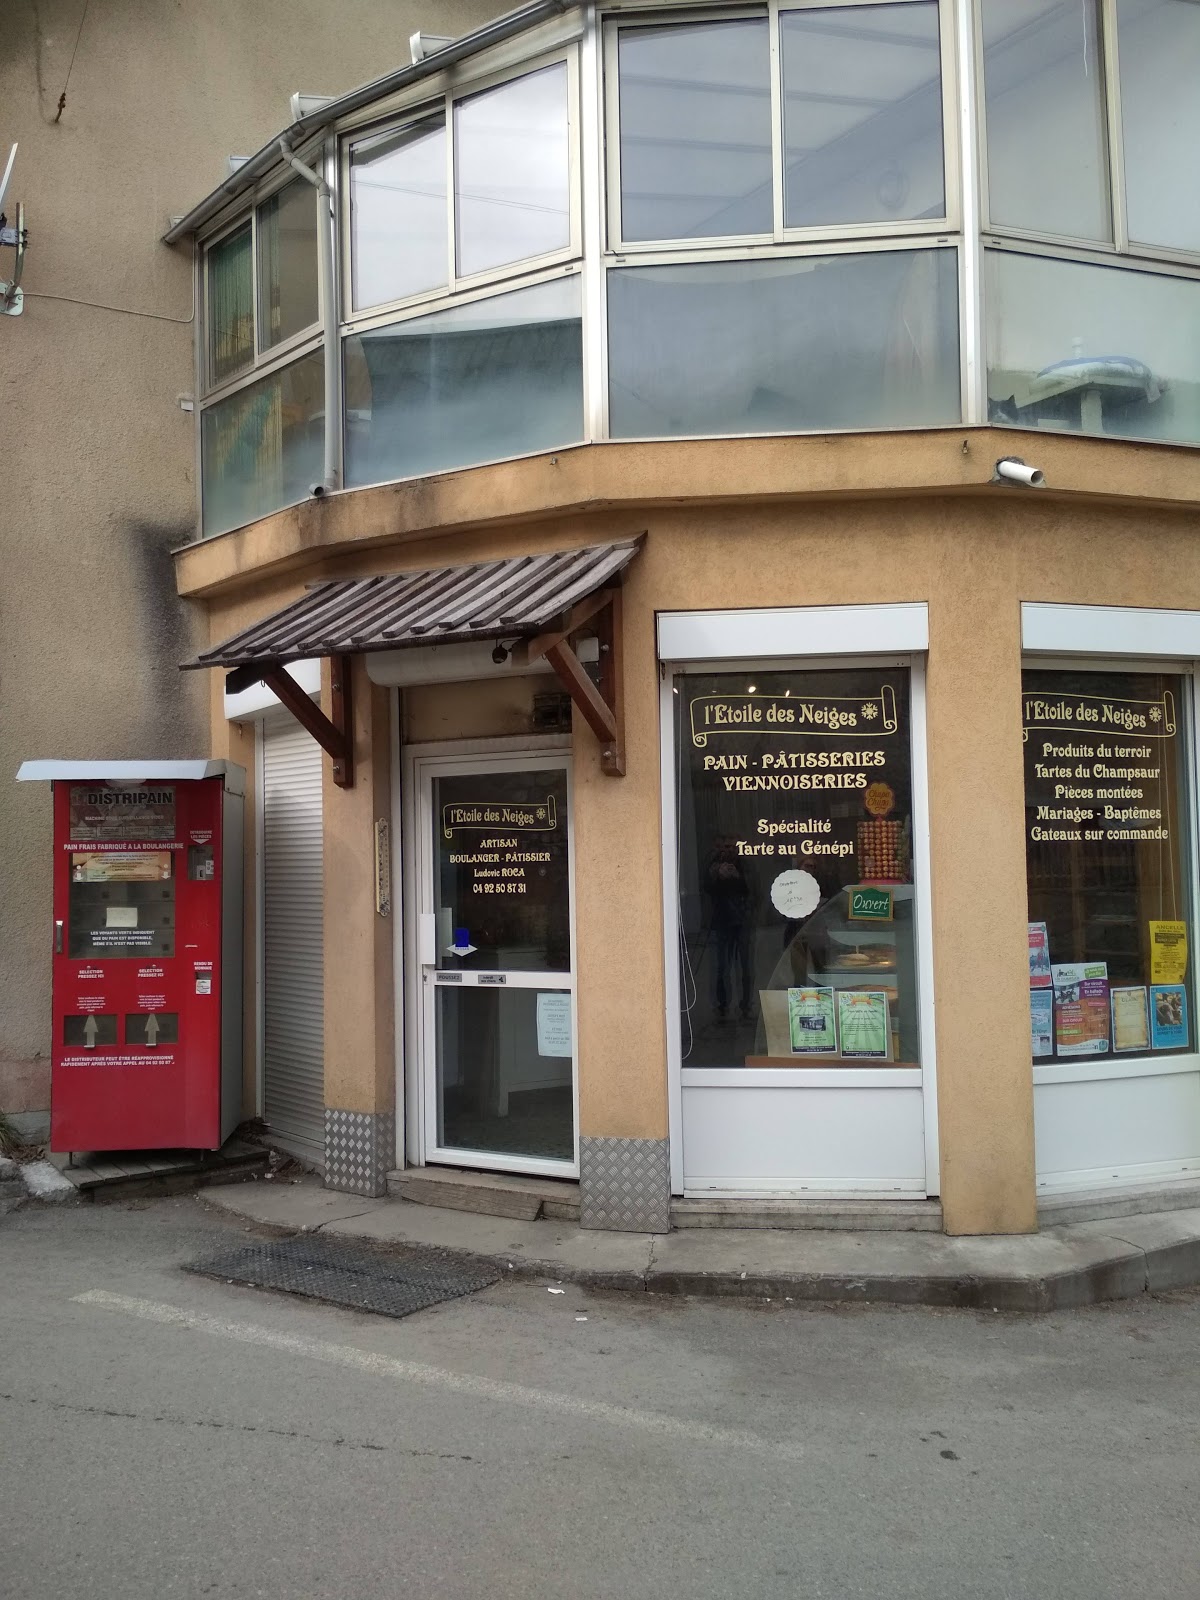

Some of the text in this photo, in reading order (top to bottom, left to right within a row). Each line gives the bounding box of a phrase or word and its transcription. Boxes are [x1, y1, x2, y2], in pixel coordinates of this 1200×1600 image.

[705, 703, 857, 729] l'Etoile des Neiges
[1026, 701, 1146, 730] l'Etoile des Neiges
[1043, 743, 1151, 758] Produits du terroir
[704, 755, 747, 770] PAIN
[762, 751, 886, 769] PÂTISSERIES
[1035, 764, 1160, 781] Tartes du Champsaur
[722, 773, 867, 791] VIENNOISERIES
[1055, 785, 1143, 798] Pièces montées
[451, 808, 534, 826] l'Etoile des Neiges
[1037, 805, 1093, 822] Mariages
[1104, 805, 1161, 822] Baptêmes
[757, 819, 831, 836] Spécialité
[1031, 826, 1168, 841] Gateaux sur commande
[480, 839, 517, 848] ARTISAN
[736, 840, 854, 857] Tarte au Génépi
[450, 854, 500, 863] BOULANGER
[506, 852, 551, 862] PÂTISSIER
[474, 868, 525, 877] Ludovic ROCA
[473, 883, 526, 893] 04 92 50 87 31
[853, 894, 889, 910] Ouvert
